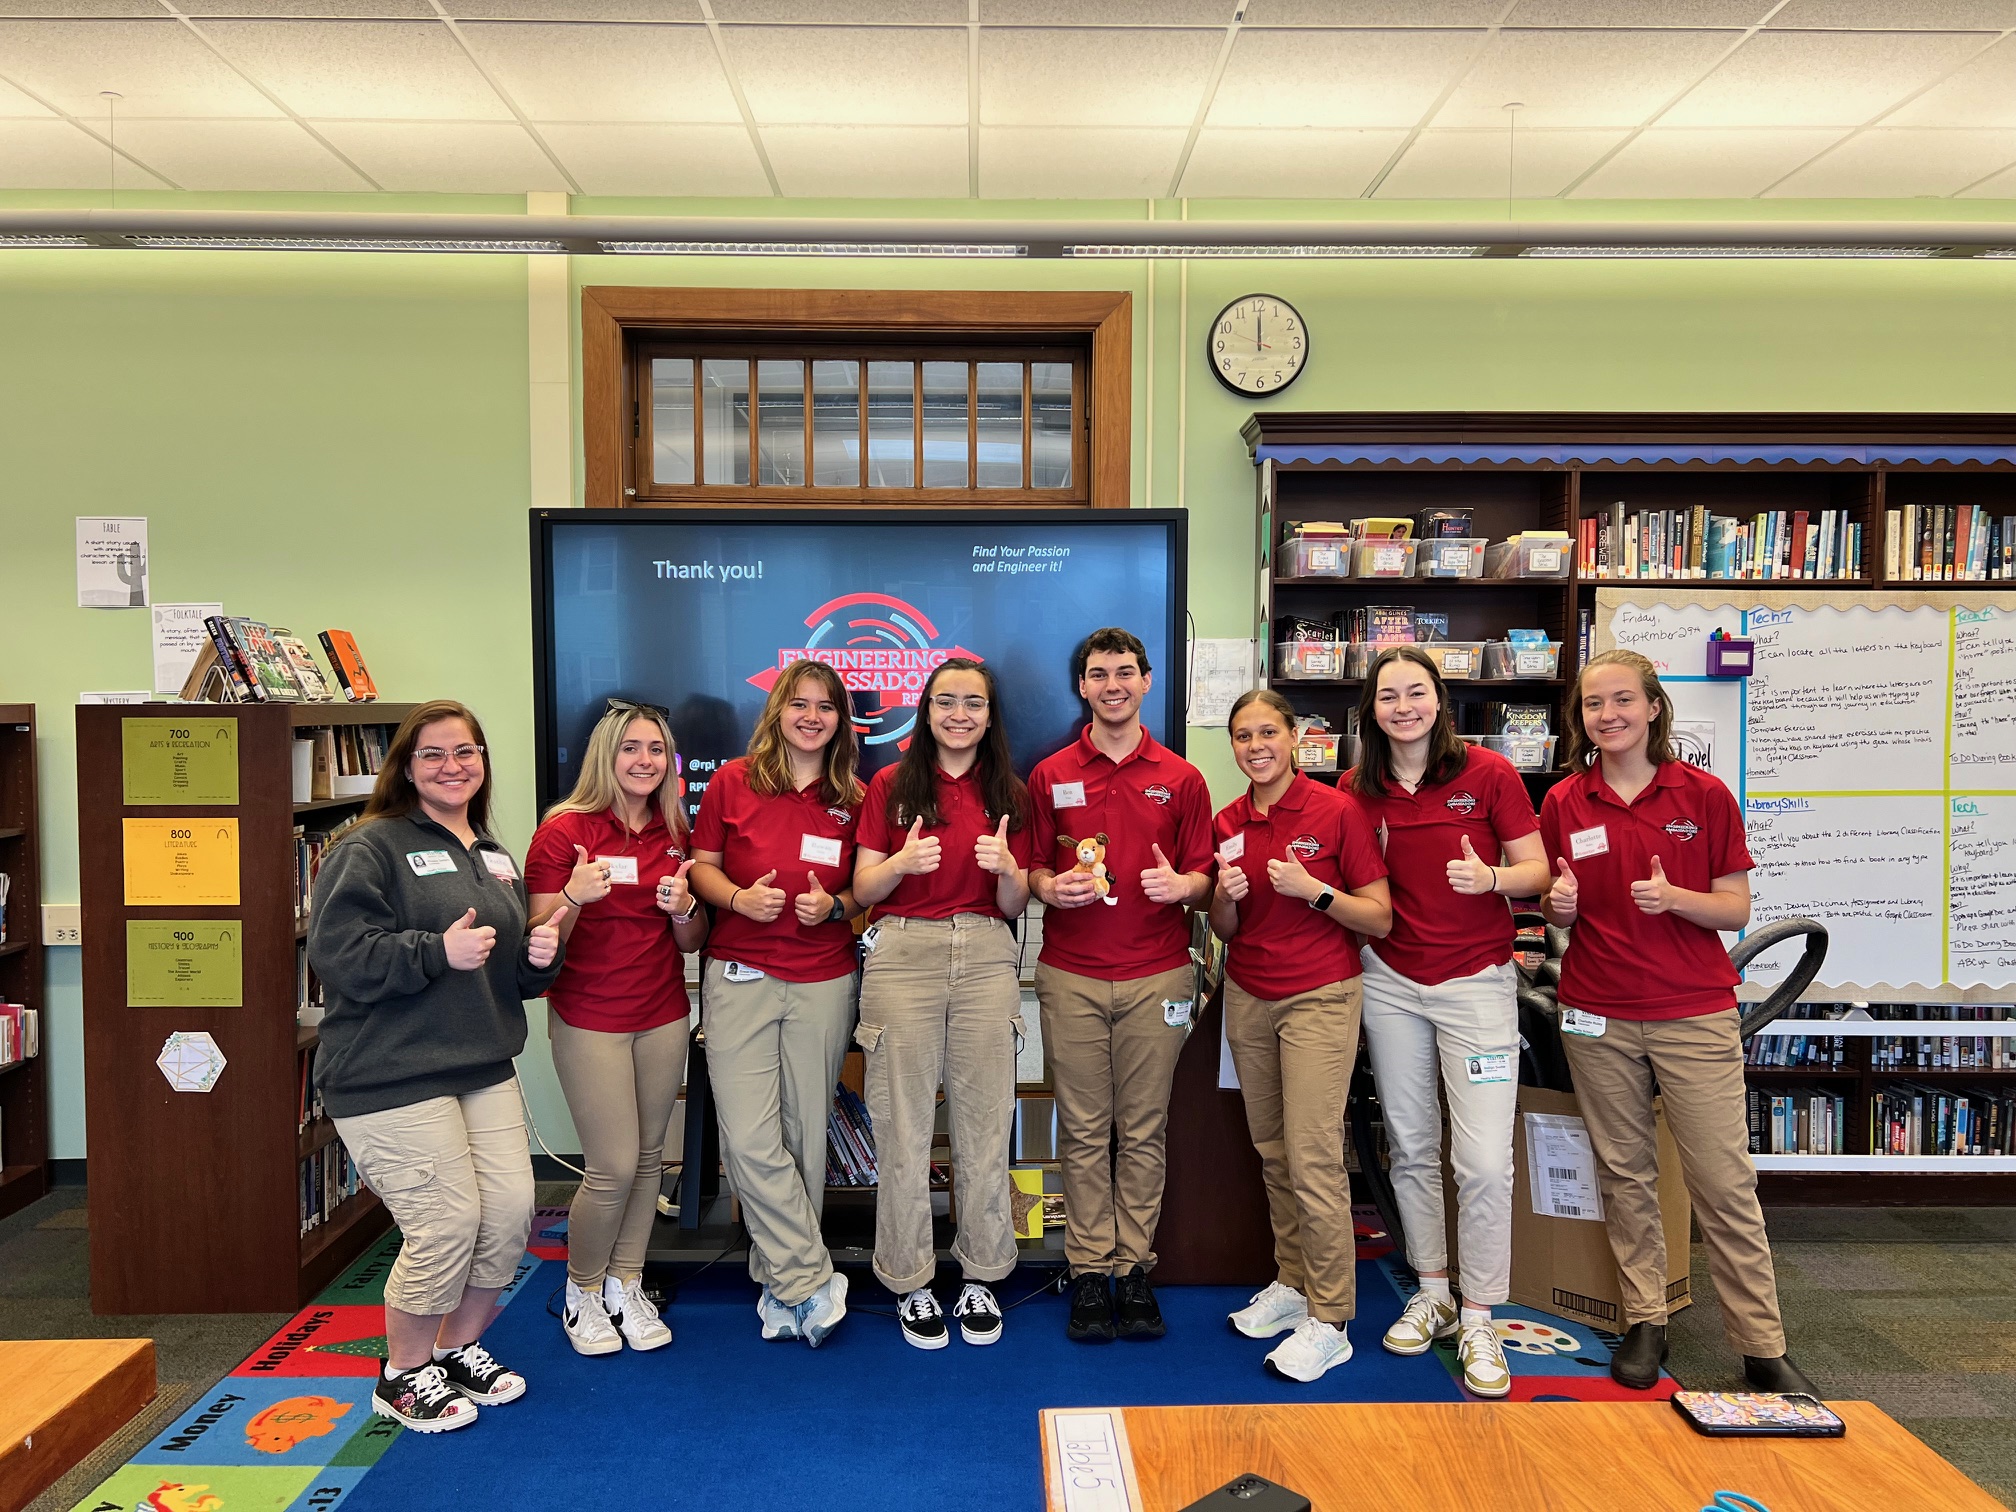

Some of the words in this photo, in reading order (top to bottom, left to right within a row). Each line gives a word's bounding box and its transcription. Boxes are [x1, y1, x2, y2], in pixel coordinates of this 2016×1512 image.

[1252, 300, 1266, 312] 12
[1273, 305, 1279, 317] 1
[1235, 307, 1245, 319] 11
[1220, 321, 1232, 334] 10
[1286, 318, 1295, 331] 2
[1217, 340, 1225, 353] 9
[1293, 337, 1301, 349] 3
[1223, 358, 1231, 371] 8
[1287, 355, 1296, 367] 4
[1238, 372, 1246, 385] 7
[1256, 376, 1264, 388] 6
[1274, 371, 1282, 383] 5
[103, 522, 120, 533] FABLE
[1442, 523, 1464, 532] HUNTED
[972, 545, 997, 558] Find
[999, 545, 1025, 558] Your
[1028, 545, 1070, 558] Passion
[1598, 529, 1608, 565] CREWEL
[653, 560, 715, 579] Thank
[720, 560, 763, 583] you!
[972, 560, 995, 573] and
[997, 560, 1047, 575] Engineer
[1049, 560, 1062, 573] it!
[173, 609, 202, 619] FOLKTALE
[1622, 612, 1661, 627] Friday,
[1955, 610, 1981, 623] Tech
[1373, 617, 1409, 625] AFTER
[1416, 617, 1445, 626] TOLKIEN
[241, 625, 266, 638] DEEP
[1296, 623, 1334, 643] Scarlet
[1381, 626, 1402, 634] THE
[1618, 630, 1678, 646] September
[1678, 626, 1701, 639] 29th
[1956, 628, 1980, 640] What?
[1377, 634, 1406, 642] GAME
[1751, 631, 1780, 645] What?
[1983, 638, 1997, 647] tell
[1768, 651, 1785, 659] can
[1788, 648, 1814, 658] locate
[1819, 646, 1832, 655] all
[1833, 646, 1848, 654] the
[1852, 644, 1876, 653] letters
[1894, 641, 1909, 650] the
[1909, 640, 1943, 654] keyboard
[1955, 667, 1974, 681] Why?
[1748, 675, 1769, 687] Why?
[1972, 680, 2003, 689] important
[1754, 687, 1766, 698] It
[1780, 686, 1817, 697] important
[1833, 683, 1853, 692] learn
[1763, 697, 1793, 706] keyboard
[1850, 693, 1863, 701] help
[1888, 692, 1909, 700] typing
[1844, 702, 1869, 711] journey
[1506, 712, 1547, 720] KINGDOM
[1954, 708, 1972, 719] How?
[169, 729, 190, 739] 700
[1750, 726, 1782, 734] Complete
[1784, 725, 1816, 733] Exercises
[1804, 734, 1826, 742] shared
[1847, 729, 1877, 737] exercises
[1812, 743, 1839, 752] keyboard
[1767, 753, 1787, 765] Google
[1949, 753, 1959, 762] To
[1960, 753, 1971, 763] Do
[1972, 753, 1996, 765] During
[1746, 798, 1781, 816] Library
[1781, 797, 1809, 809] Skills
[1951, 795, 1979, 814] Tech
[1747, 818, 1774, 831] What?
[1951, 821, 1975, 834] What?
[170, 829, 192, 839] 800
[1575, 833, 1602, 845] Charlotte
[1769, 832, 1784, 842] tell
[1787, 836, 1800, 844] you
[1821, 830, 1832, 838] the
[1842, 829, 1872, 838] different
[1877, 829, 1900, 837] Library
[1900, 826, 1941, 836] Classification
[1976, 838, 1990, 847] tell
[1992, 841, 2008, 852] you
[1801, 859, 1816, 867] know
[1843, 855, 1858, 865] find
[1898, 856, 1911, 865] any
[1912, 854, 1928, 865] type
[1950, 862, 1970, 875] Why?
[1784, 902, 1810, 911] Dewey
[1901, 898, 1924, 907] Library
[1957, 922, 1978, 932] Please
[2001, 919, 2015, 928] with
[173, 931, 194, 941] 900
[182, 943, 219, 951] GEOGRAPHY
[1950, 939, 1961, 949] To
[1962, 941, 1973, 949] Do
[1975, 940, 2002, 950] During
[342, 1260, 385, 1290] Fairy
[251, 1310, 334, 1372] Holidays
[161, 1393, 246, 1452] Money
[1065, 1432, 1112, 1474] Table
